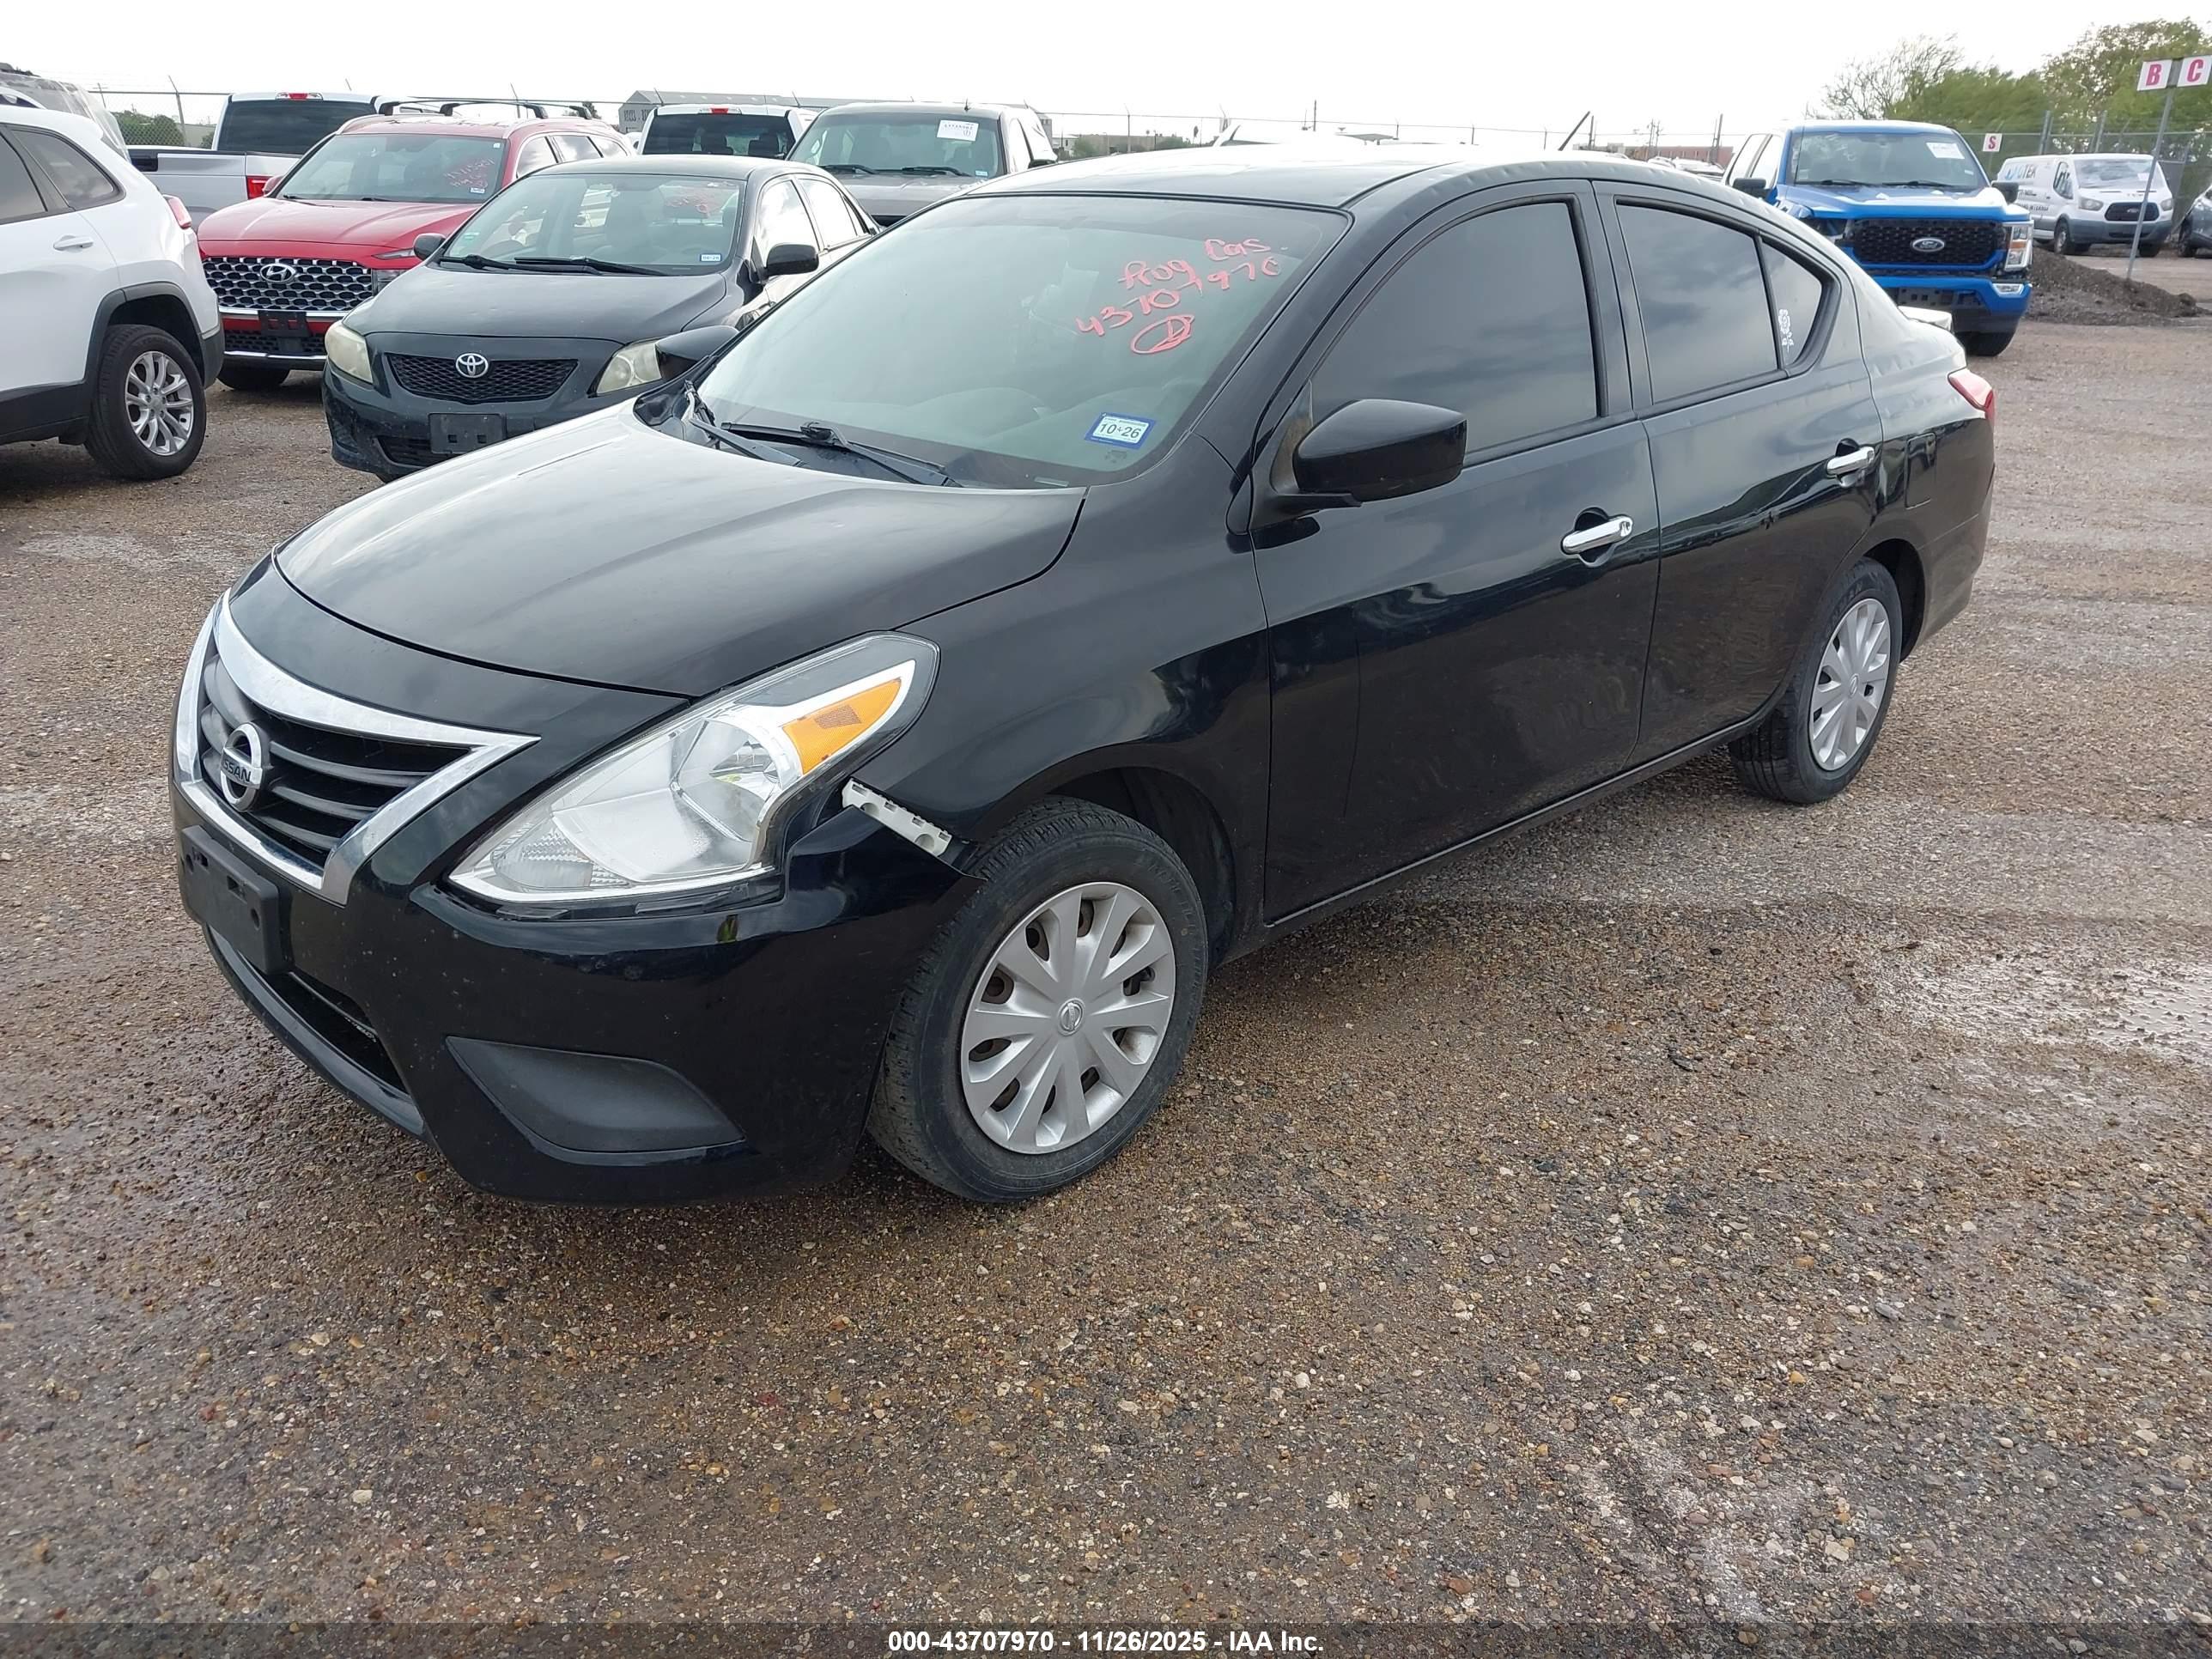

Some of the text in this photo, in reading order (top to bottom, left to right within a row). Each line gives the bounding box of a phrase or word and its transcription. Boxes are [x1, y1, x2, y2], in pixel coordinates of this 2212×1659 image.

[2146, 64, 2161, 86] B
[2187, 58, 2203, 82] C
[1988, 136, 1996, 149] S
